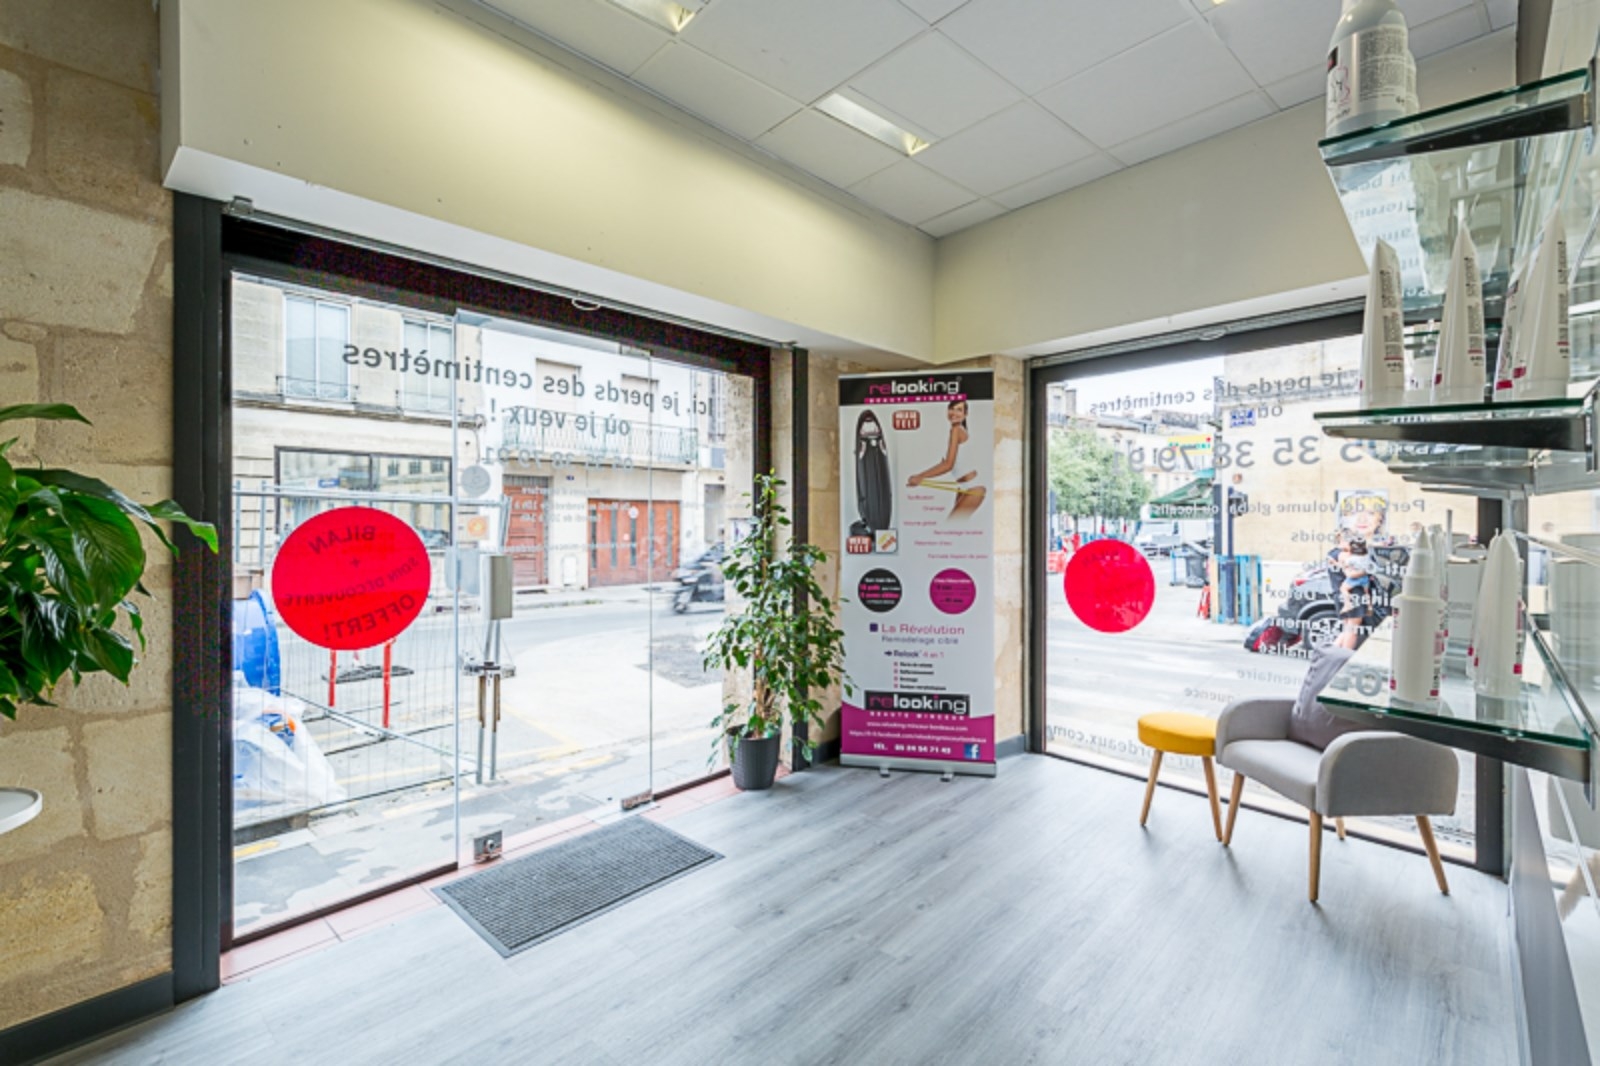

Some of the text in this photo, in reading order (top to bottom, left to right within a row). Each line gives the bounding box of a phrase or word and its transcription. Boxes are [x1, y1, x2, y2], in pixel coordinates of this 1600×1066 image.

[868, 377, 959, 396] relooking
[881, 622, 965, 635] La Révolution
[869, 694, 966, 714] relooking
